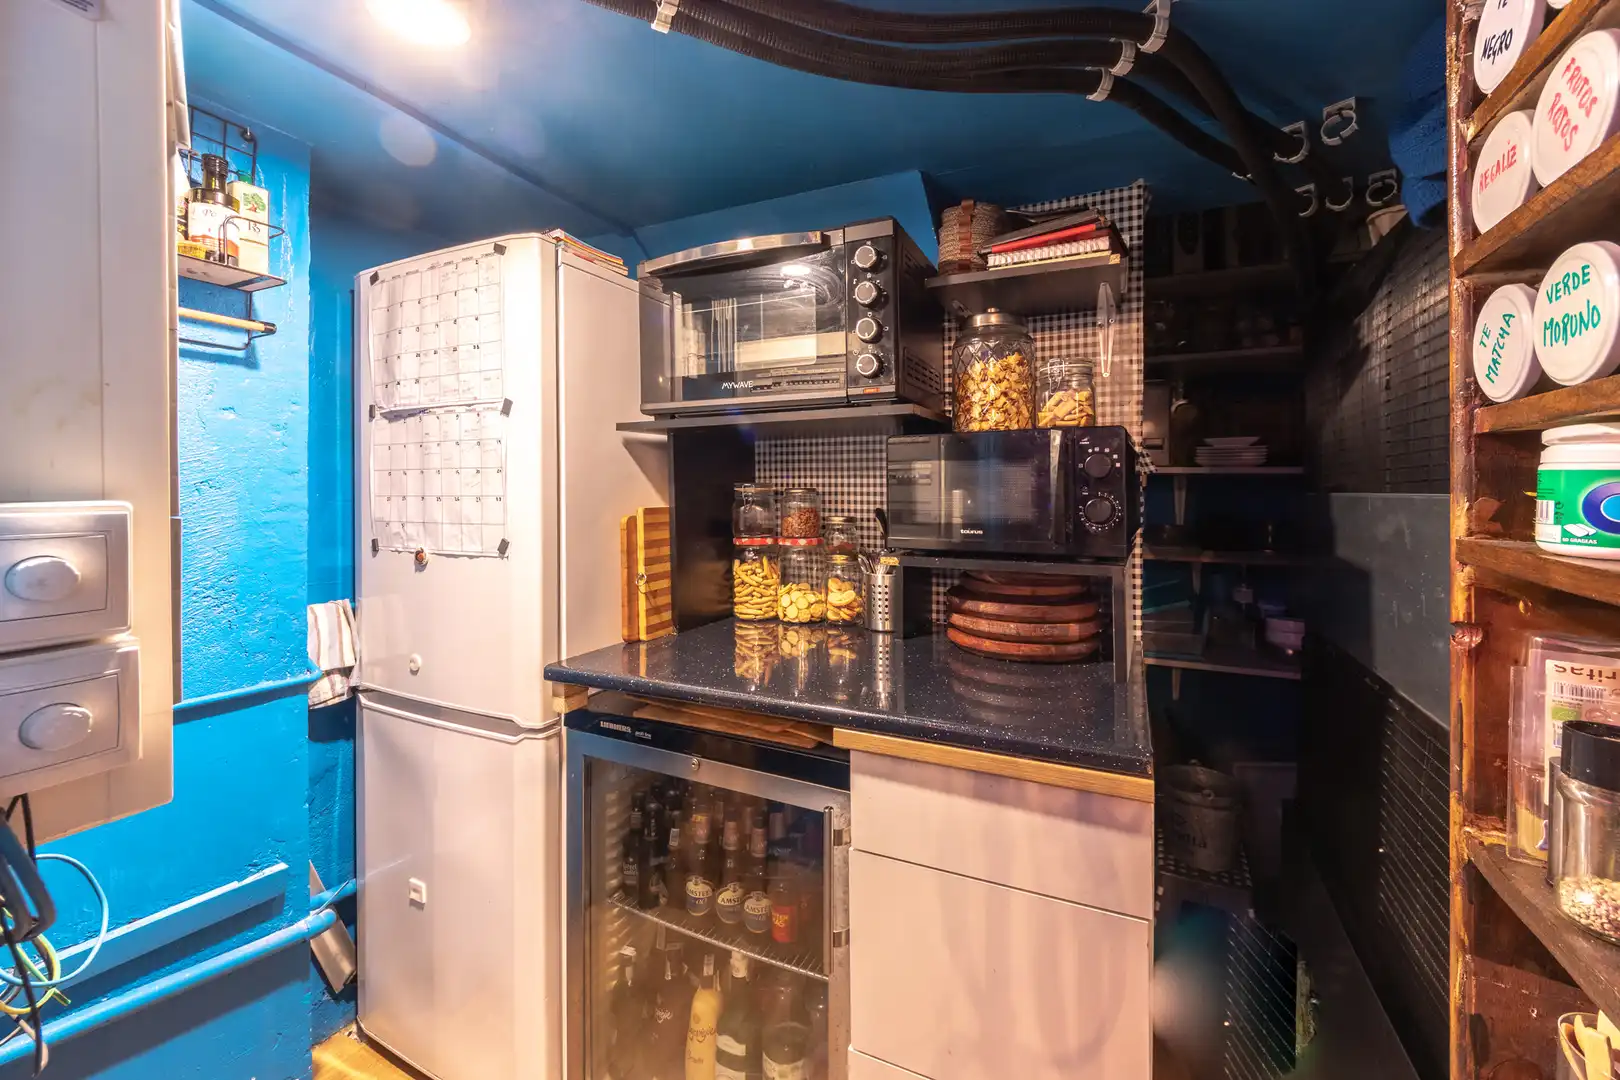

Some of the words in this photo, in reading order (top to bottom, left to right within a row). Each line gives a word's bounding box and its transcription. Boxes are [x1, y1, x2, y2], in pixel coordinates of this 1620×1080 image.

[1480, 28, 1514, 65] NEGRO
[1561, 57, 1598, 118] FRUTOS
[1547, 92, 1579, 152] ROJOS
[1546, 264, 1591, 304] VERDE
[1479, 323, 1492, 348] TE
[1543, 298, 1601, 347] MORUNO
[1485, 313, 1516, 384] MATCHA
[721, 380, 754, 390] MYWAVE
